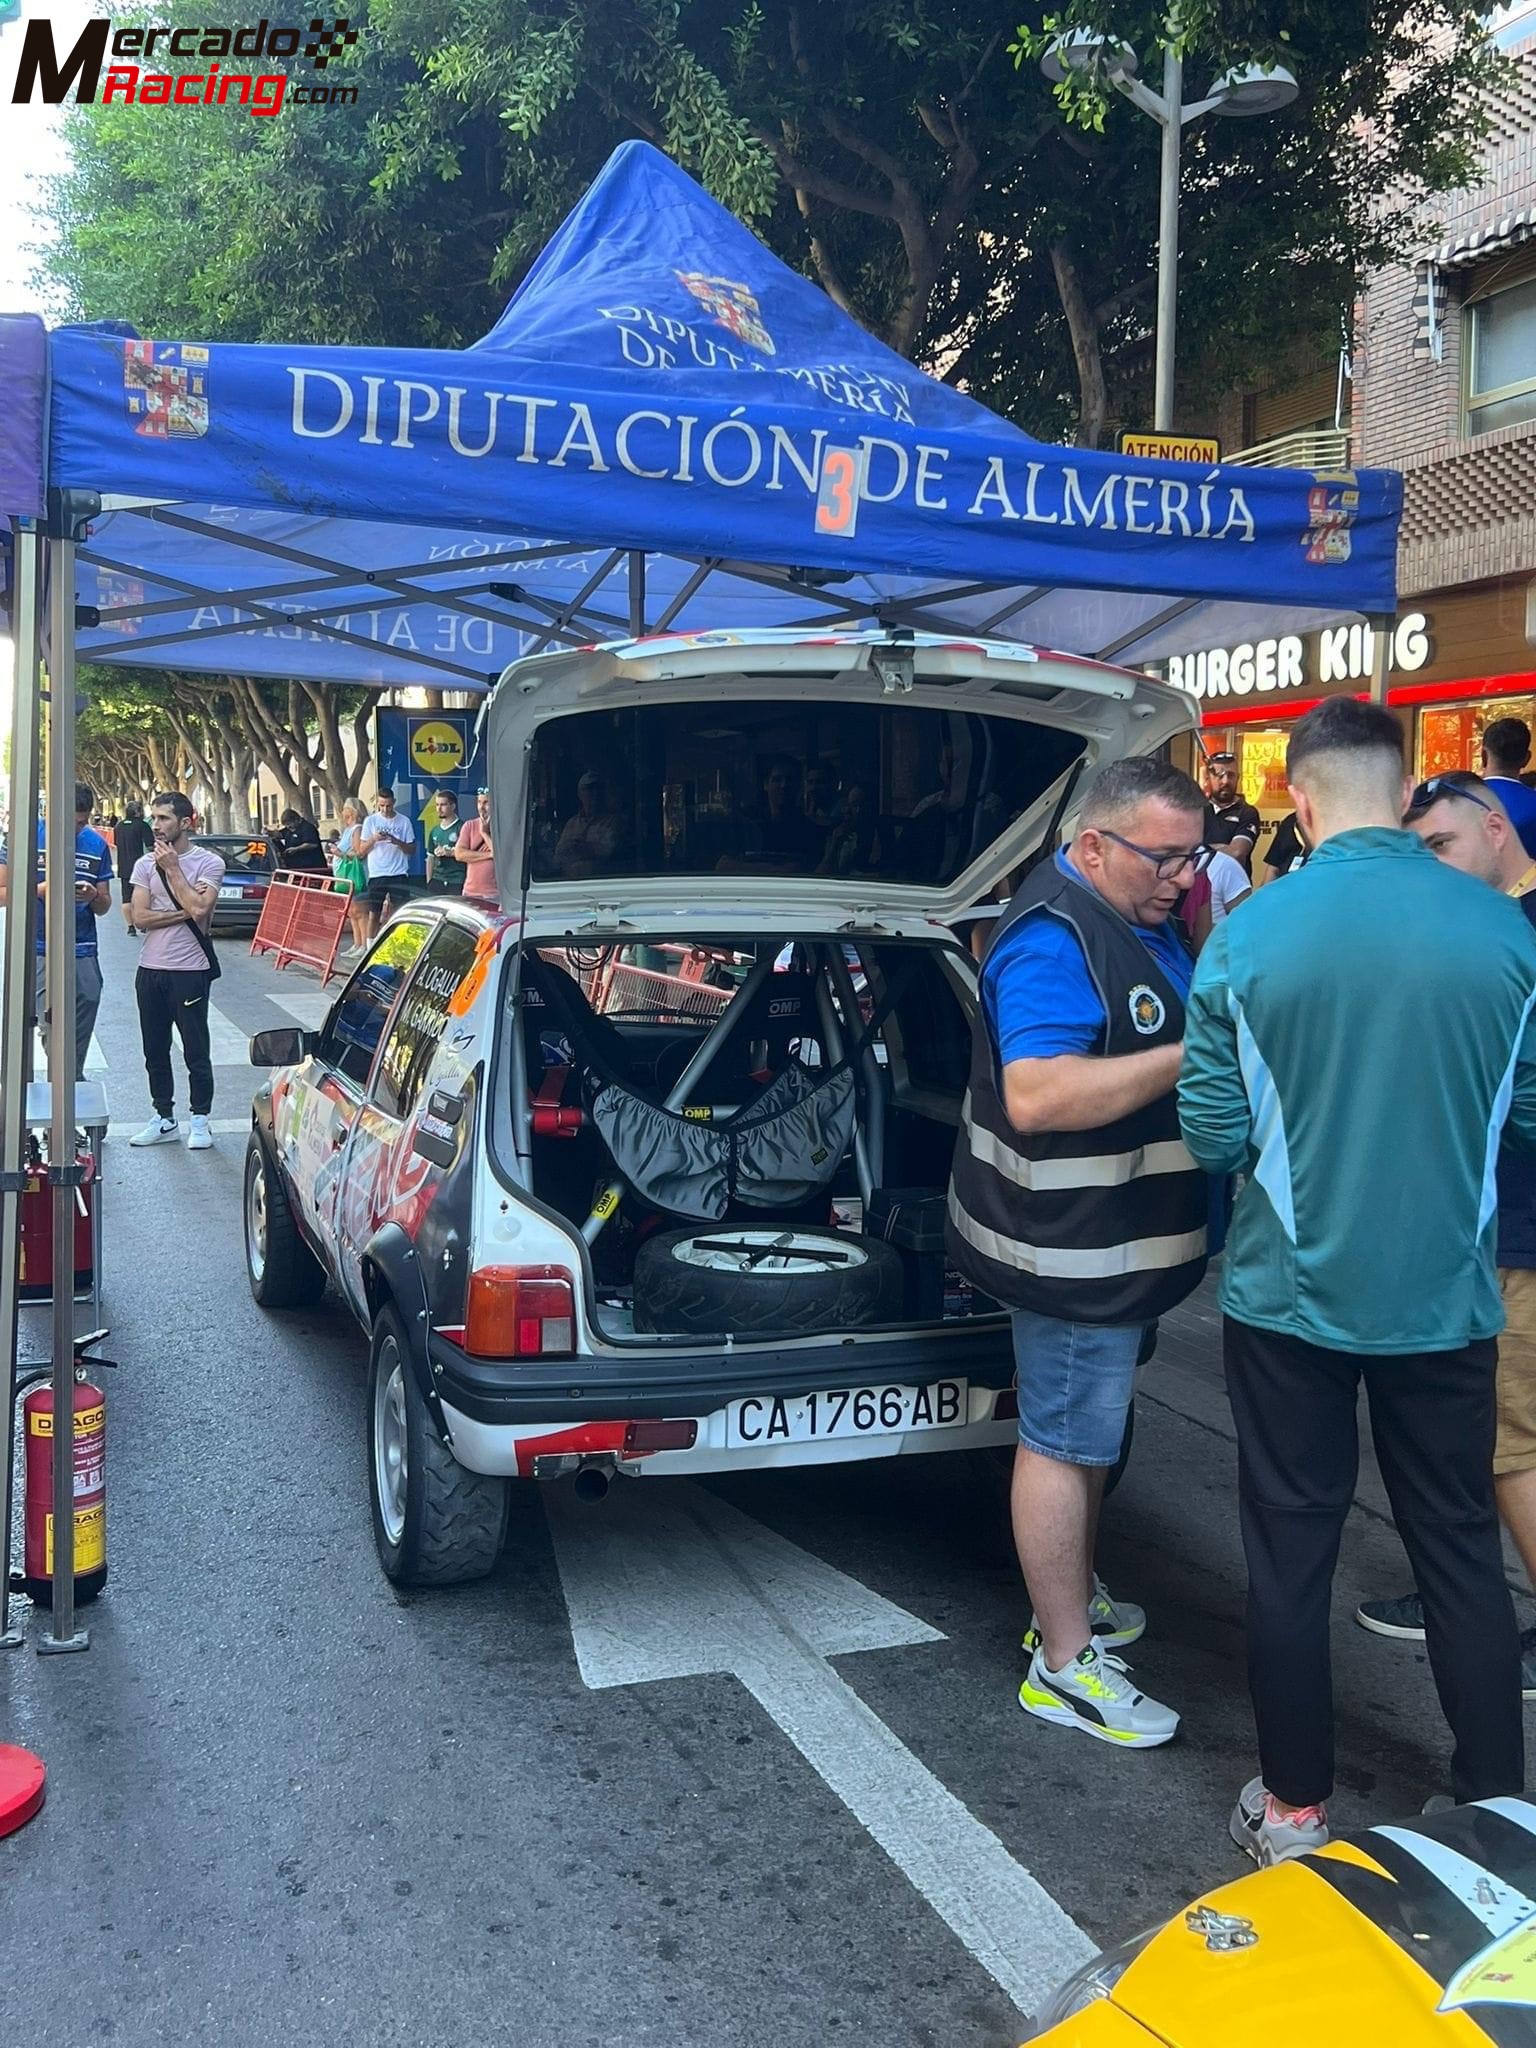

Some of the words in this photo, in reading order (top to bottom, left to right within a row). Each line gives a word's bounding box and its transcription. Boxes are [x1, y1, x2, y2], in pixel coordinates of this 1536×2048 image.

[286, 366, 829, 493] DIPUTACIÓN
[858, 435, 950, 510] DE
[967, 457, 1257, 543] ALMERÍA
[1125, 442, 1214, 464] ATENCIÓN
[817, 450, 856, 532] 3
[1168, 635, 1304, 701] BURGER
[247, 841, 267, 858] 25
[426, 965, 461, 997] OGALLA
[768, 1000, 801, 1014] OMP
[684, 1108, 712, 1119] OMP
[596, 1193, 611, 1213] OMP
[38, 1411, 104, 1429] DAGO
[738, 1398, 790, 1441] CA
[806, 1386, 902, 1436] 1766
[911, 1381, 961, 1427] AB
